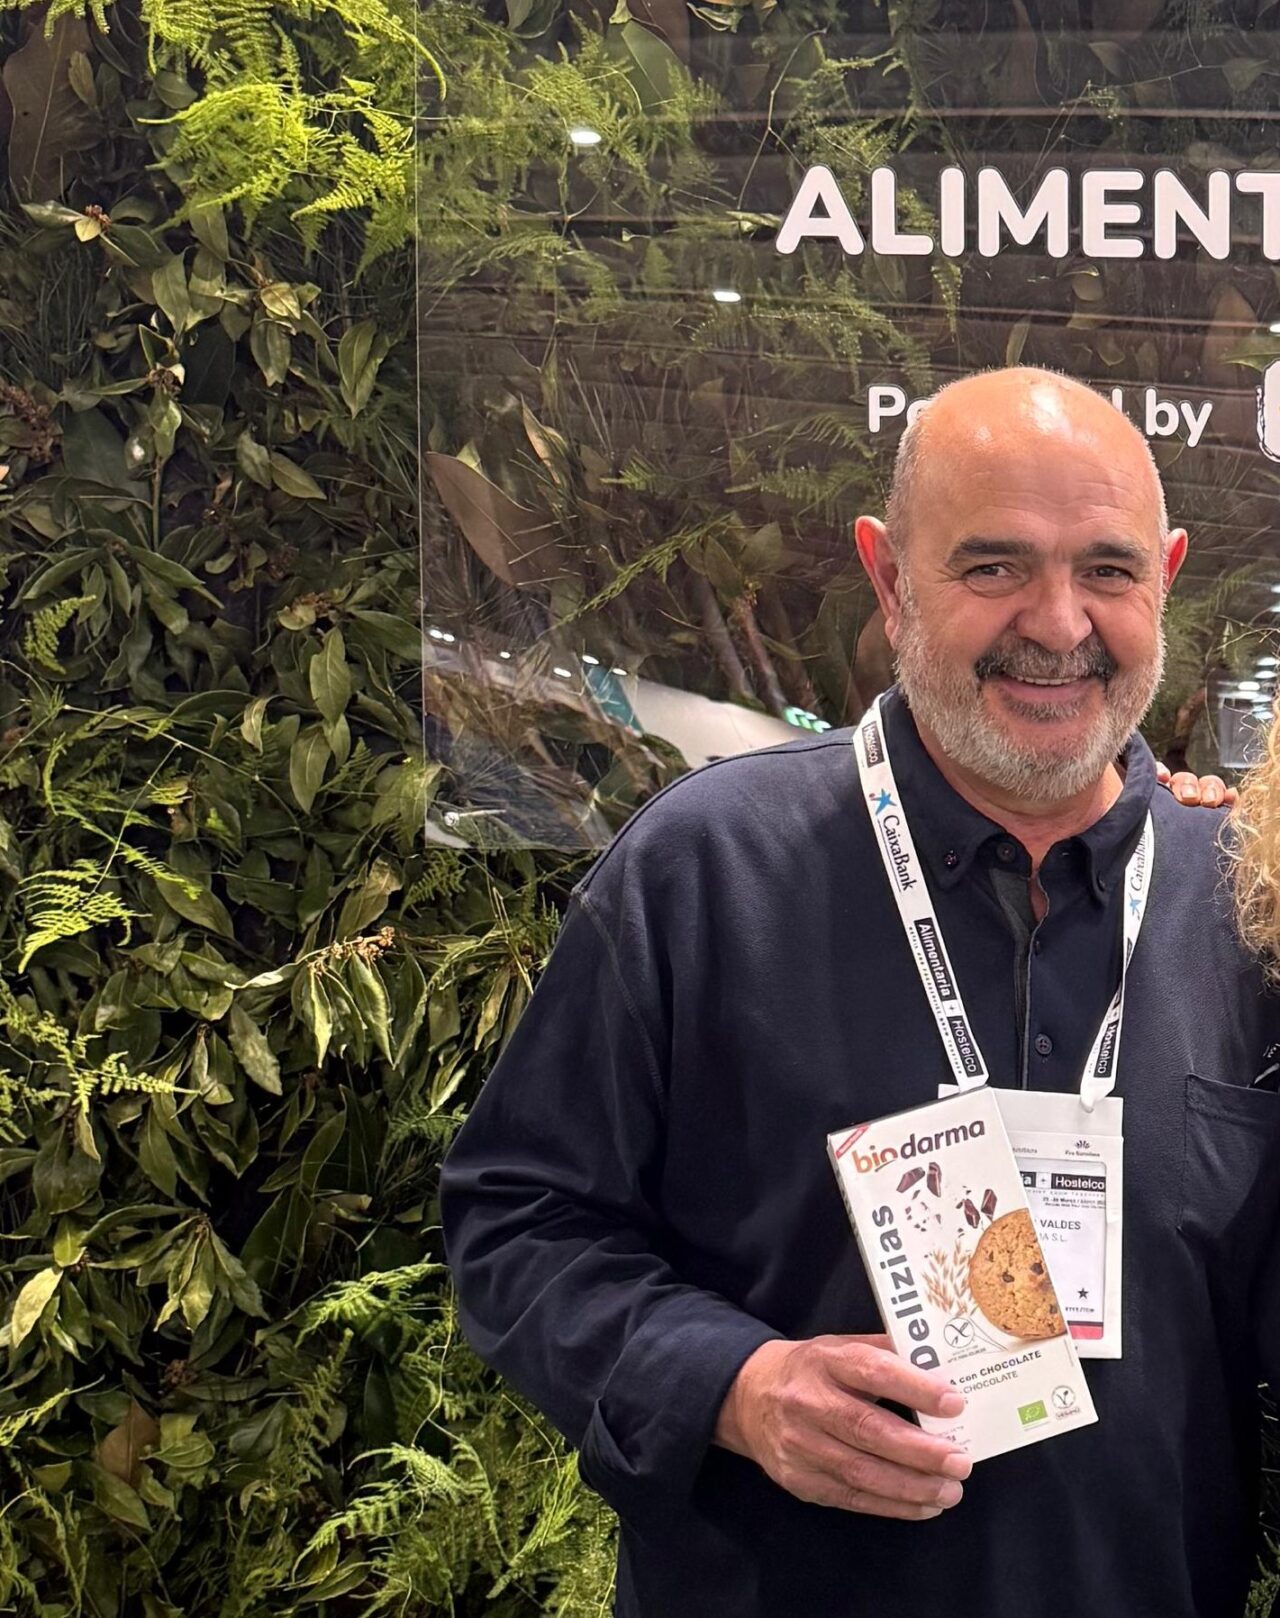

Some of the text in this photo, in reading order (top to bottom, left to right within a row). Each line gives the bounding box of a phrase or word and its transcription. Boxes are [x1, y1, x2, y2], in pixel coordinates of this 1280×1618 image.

[1145, 387, 1213, 447] by
[883, 814, 917, 892] CaixaBank
[918, 922, 952, 998] Alimentaria
[951, 1020, 977, 1074] Hostelco
[852, 1120, 985, 1174] biodarma
[1055, 1176, 1105, 1190] Hostelco
[1040, 1219, 1081, 1230] VALDES
[872, 1205, 941, 1371] Delizias
[959, 1372, 978, 1384] con
[979, 1350, 1042, 1377] CHOCOLATE
[963, 1370, 1019, 1394] CHOCOLATE
